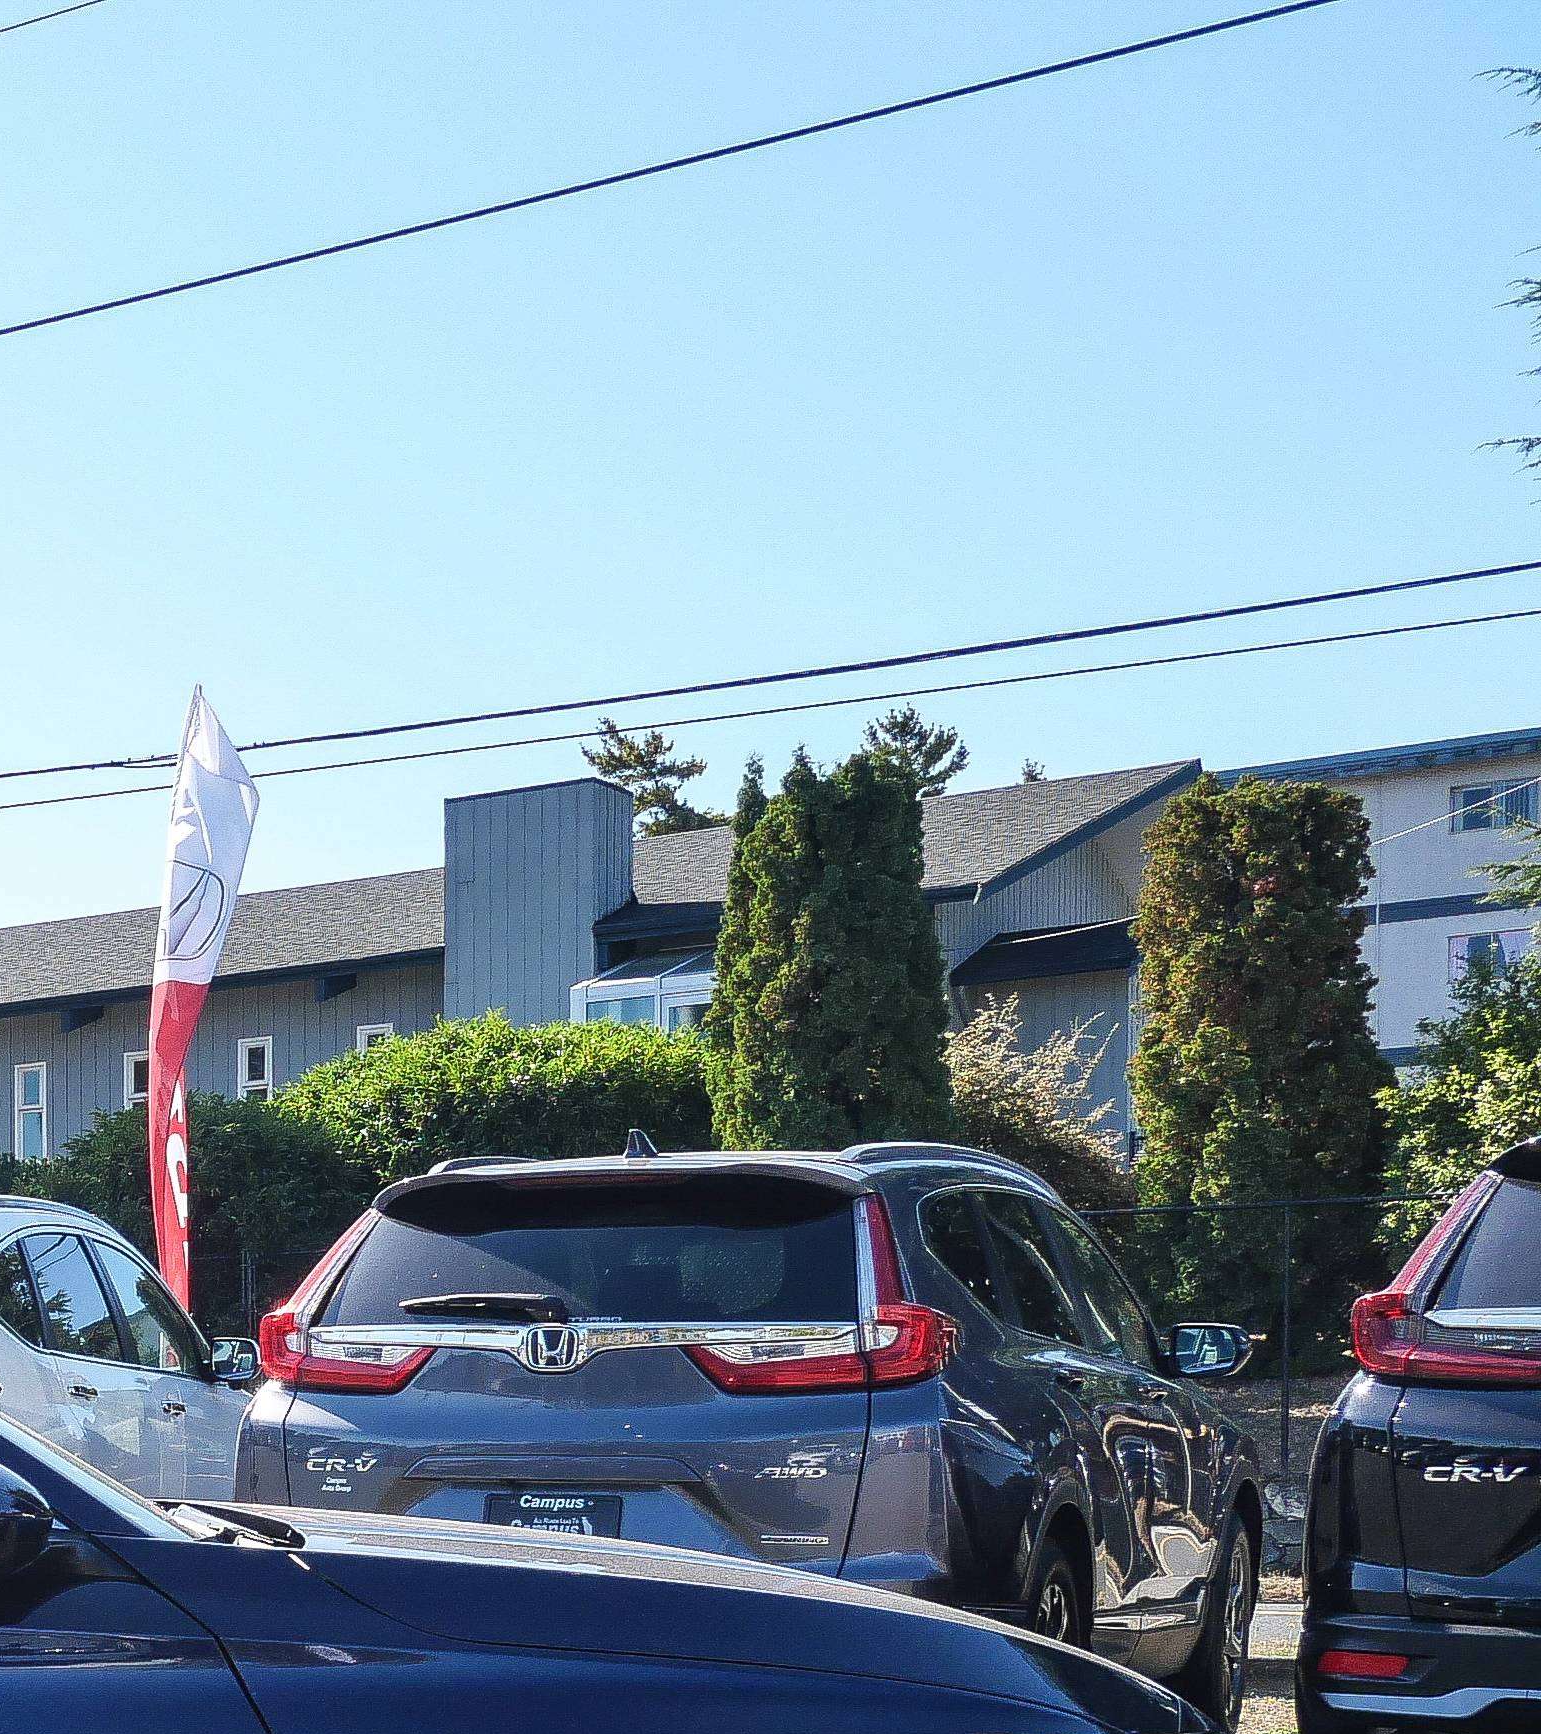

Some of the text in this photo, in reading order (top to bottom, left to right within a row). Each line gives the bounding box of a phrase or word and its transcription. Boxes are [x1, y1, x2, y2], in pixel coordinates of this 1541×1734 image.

[305, 1458, 379, 1473] CR-V
[1423, 1465, 1530, 1483] CR-V
[519, 1494, 585, 1512] Campus
